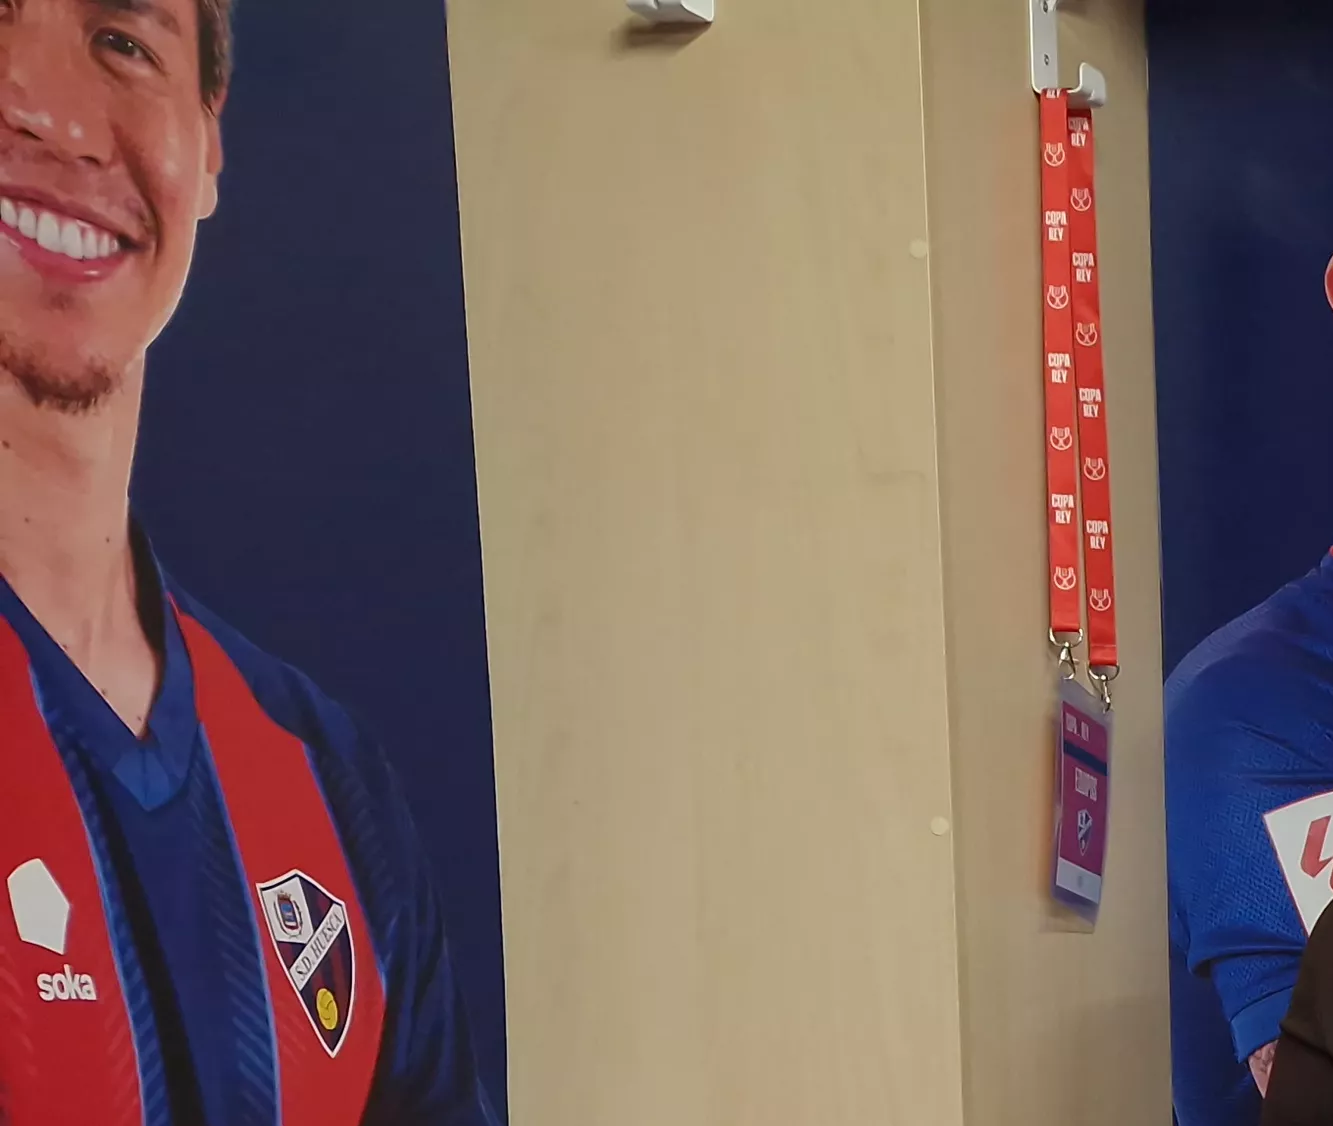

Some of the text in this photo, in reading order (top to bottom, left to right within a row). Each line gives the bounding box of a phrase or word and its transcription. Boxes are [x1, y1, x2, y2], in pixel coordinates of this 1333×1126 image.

[1071, 132, 1086, 147] REY
[1045, 210, 1068, 226] COPA
[1048, 227, 1064, 241] REY
[1072, 252, 1095, 267] COPA
[1076, 268, 1092, 283] REY
[1047, 352, 1071, 368] COPA
[1051, 369, 1068, 383] REY
[1079, 388, 1102, 403] COPA
[1083, 404, 1099, 418] REY
[1051, 493, 1074, 508] COPA
[1055, 509, 1071, 524] REY
[1086, 519, 1109, 534] COPA
[1090, 535, 1106, 550] REY
[37, 964, 97, 1001] soka
